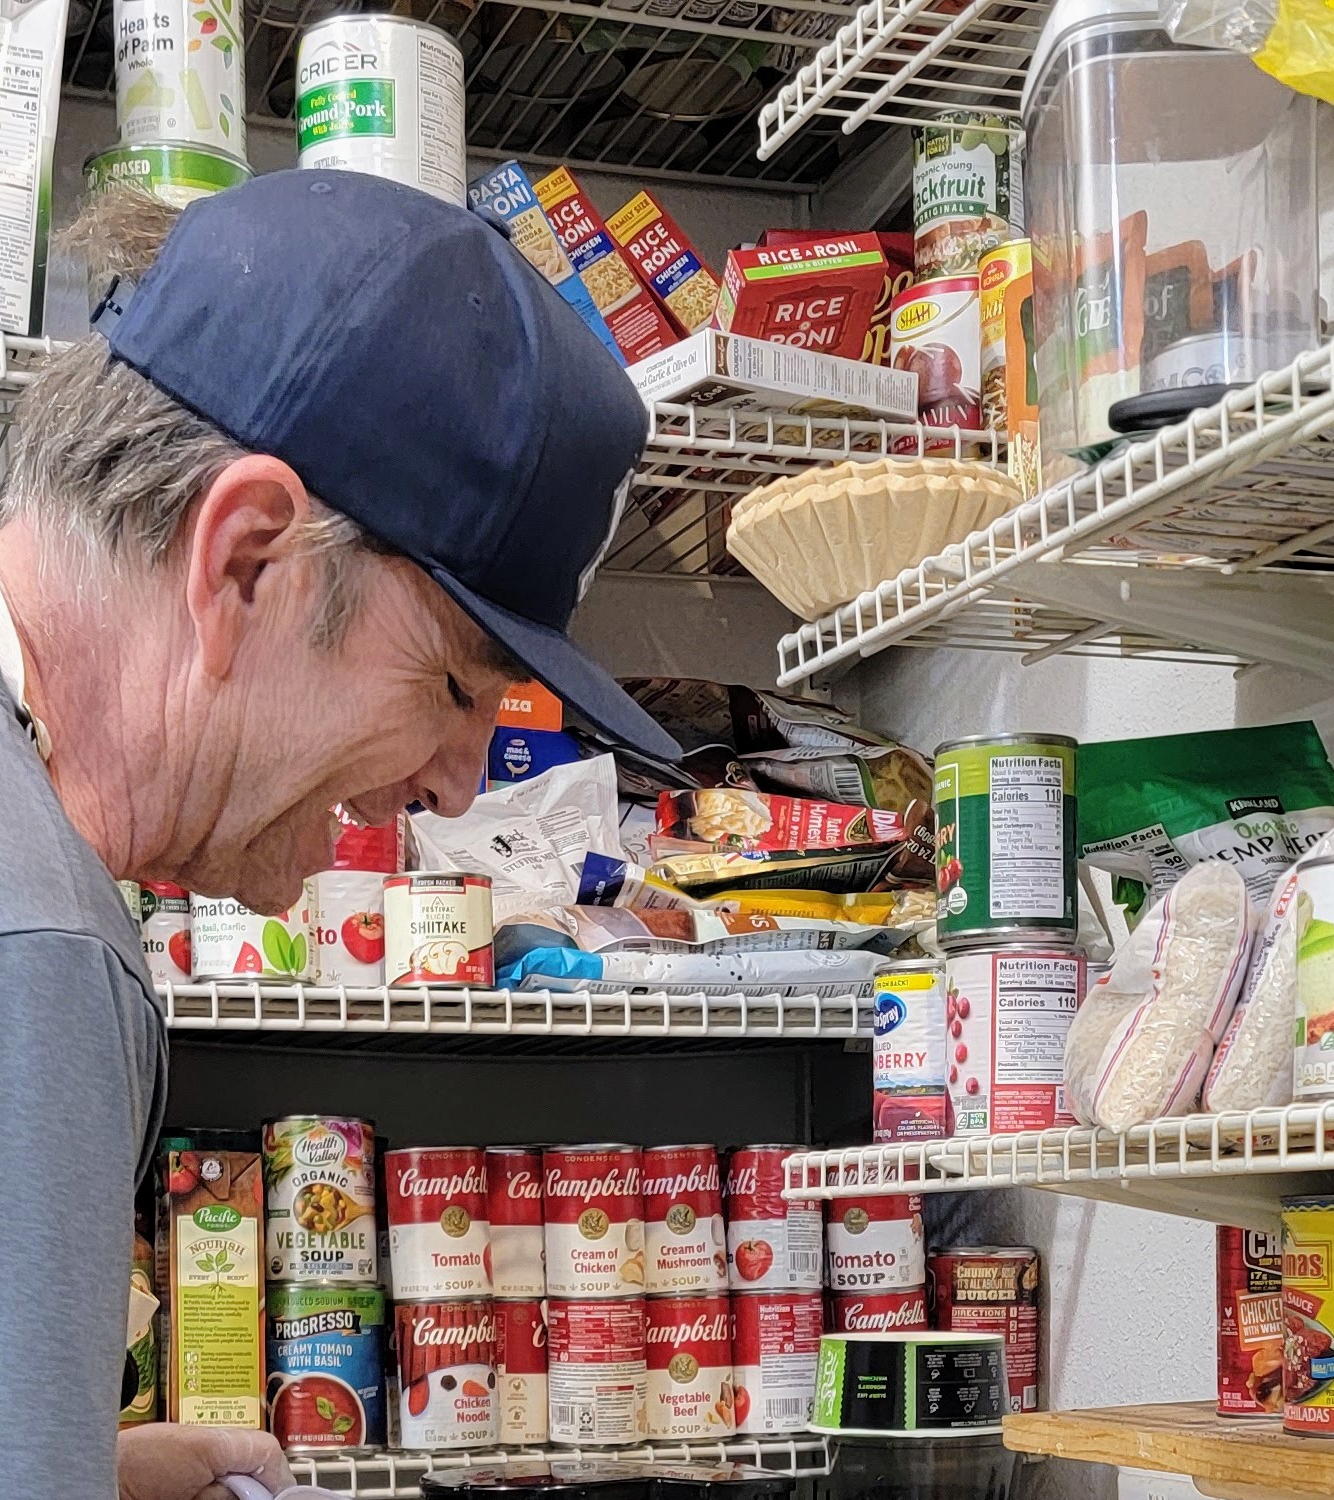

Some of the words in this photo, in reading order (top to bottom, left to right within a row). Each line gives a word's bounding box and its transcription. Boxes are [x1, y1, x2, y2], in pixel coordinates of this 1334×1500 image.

[344, 100, 387, 117] Pork
[942, 161, 973, 172] Young
[468, 168, 523, 208] PASTA
[918, 207, 964, 224] ORIGINAL
[629, 222, 669, 260] RICE
[641, 238, 682, 276] RONI
[757, 247, 803, 266] RICE
[655, 255, 690, 286] CHICKEN
[774, 295, 845, 323] RICE
[991, 758, 1037, 769] Nutrition
[1038, 758, 1062, 769] Facts
[992, 791, 1029, 802] Calories
[1045, 788, 1062, 802] 110
[410, 920, 468, 936] SHIITAKE
[999, 961, 1050, 972] Nutrition
[1053, 961, 1077, 973] Facts
[999, 998, 1046, 1008] Calories
[1057, 995, 1077, 1009] 110
[301, 1135, 339, 1155] Health
[309, 1151, 343, 1167] Valley
[292, 1170, 349, 1190] ORGANIC
[546, 1168, 641, 1203] Campbell's
[198, 1206, 239, 1223] Pacific
[189, 1238, 246, 1257] NOURISH
[276, 1231, 366, 1250] VEGETABLE
[300, 1250, 344, 1263] SOUP
[570, 1249, 605, 1261] Cream
[607, 1248, 619, 1260] of
[660, 1245, 695, 1257] Cream
[696, 1242, 707, 1254] of
[431, 1252, 481, 1267] Tomato
[656, 1256, 712, 1271] Mushroom
[830, 1250, 896, 1269] Tomato
[574, 1262, 616, 1274] Chicken
[444, 1280, 475, 1290] SOUP
[837, 1272, 886, 1286] SOUP
[955, 1289, 1017, 1301] BURGER
[844, 1300, 925, 1333] Campbell's
[952, 1309, 1007, 1318] DIRECTIONS
[275, 1311, 354, 1340] PROGRESSO
[277, 1343, 313, 1358] CREAMY
[315, 1343, 353, 1357] TOMATO
[287, 1356, 312, 1368] WITH
[314, 1355, 342, 1368] BASIL
[454, 1398, 491, 1410] Chicken
[658, 1391, 711, 1407] Vegetable
[456, 1411, 491, 1424] Noodle
[673, 1406, 698, 1417] Beef
